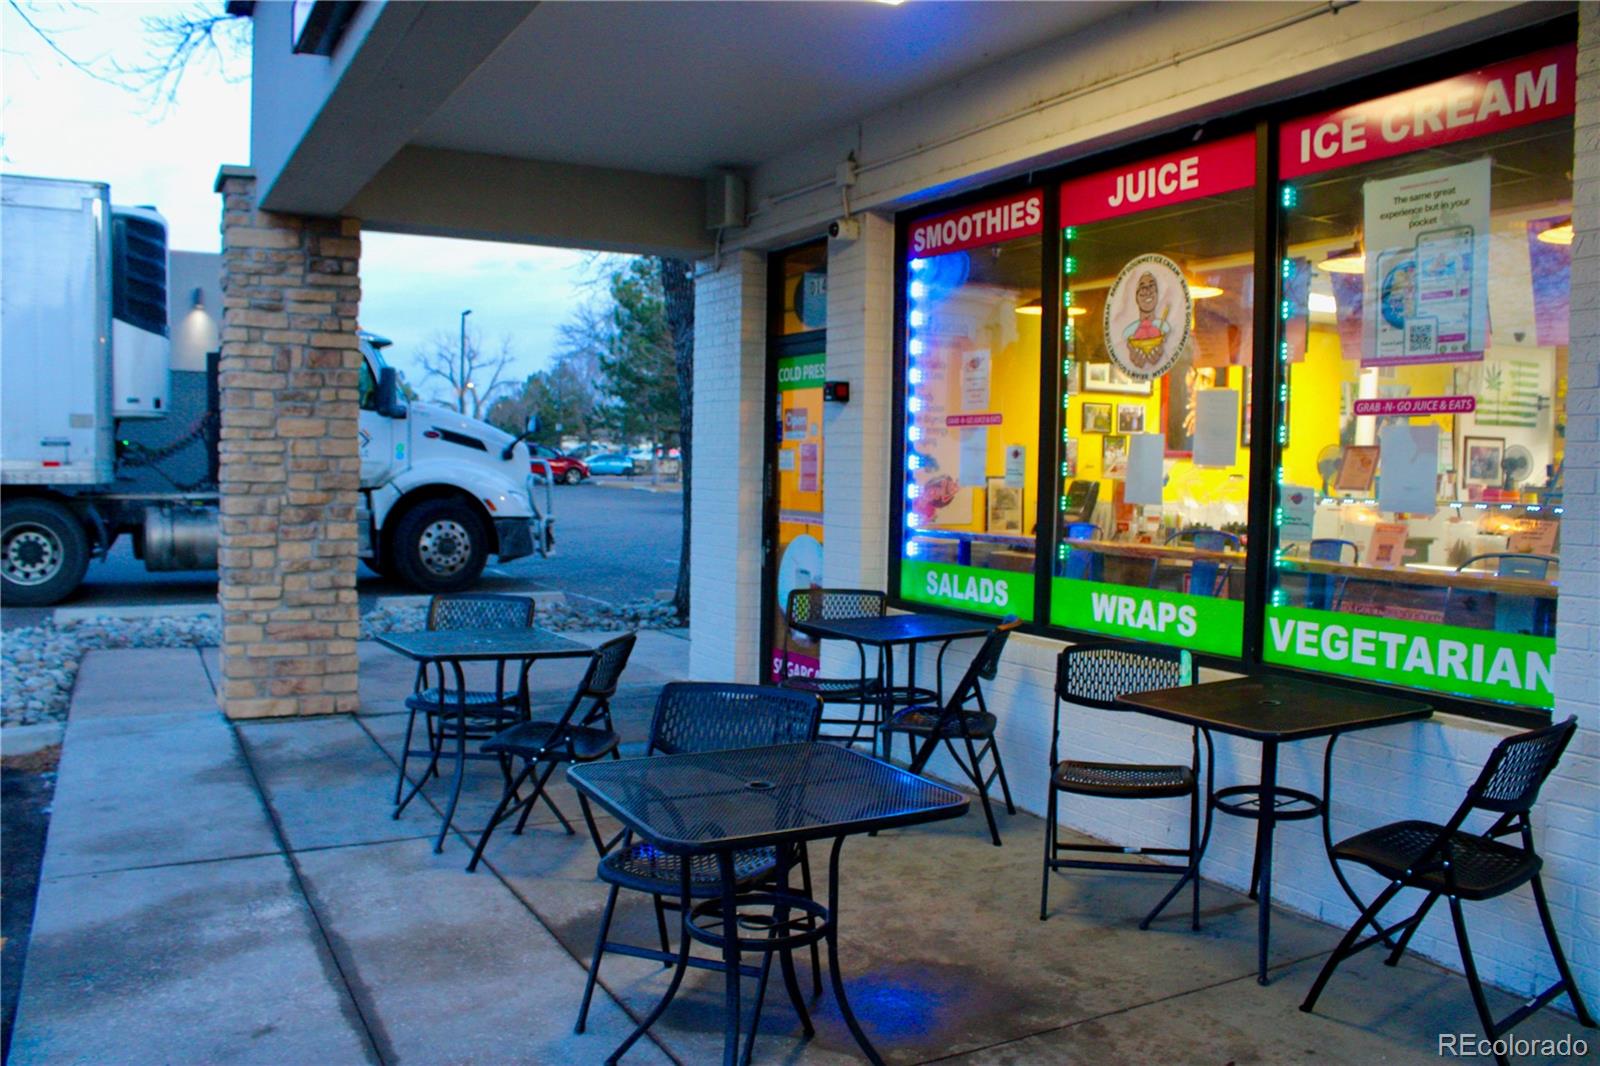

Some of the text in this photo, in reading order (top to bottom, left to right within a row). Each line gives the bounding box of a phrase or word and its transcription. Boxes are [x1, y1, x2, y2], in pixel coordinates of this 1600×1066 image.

[1300, 63, 1557, 163] ICE CREAM
[1107, 156, 1199, 208] JUICE
[1393, 186, 1457, 206] The same great
[913, 197, 1042, 253] SMOOTHIES
[1380, 198, 1472, 221] experience but in your
[1408, 216, 1438, 230] pocket
[778, 366, 801, 382] COLD
[1356, 402, 1381, 413] GRAB
[1397, 401, 1412, 411] GO
[1412, 400, 1439, 411] JUICE
[1439, 400, 1447, 410] &
[1448, 399, 1473, 410] EATS
[925, 570, 1010, 608] SALADS
[1090, 592, 1198, 637] WRAPS
[1268, 616, 1556, 694] VEGETARIAN
